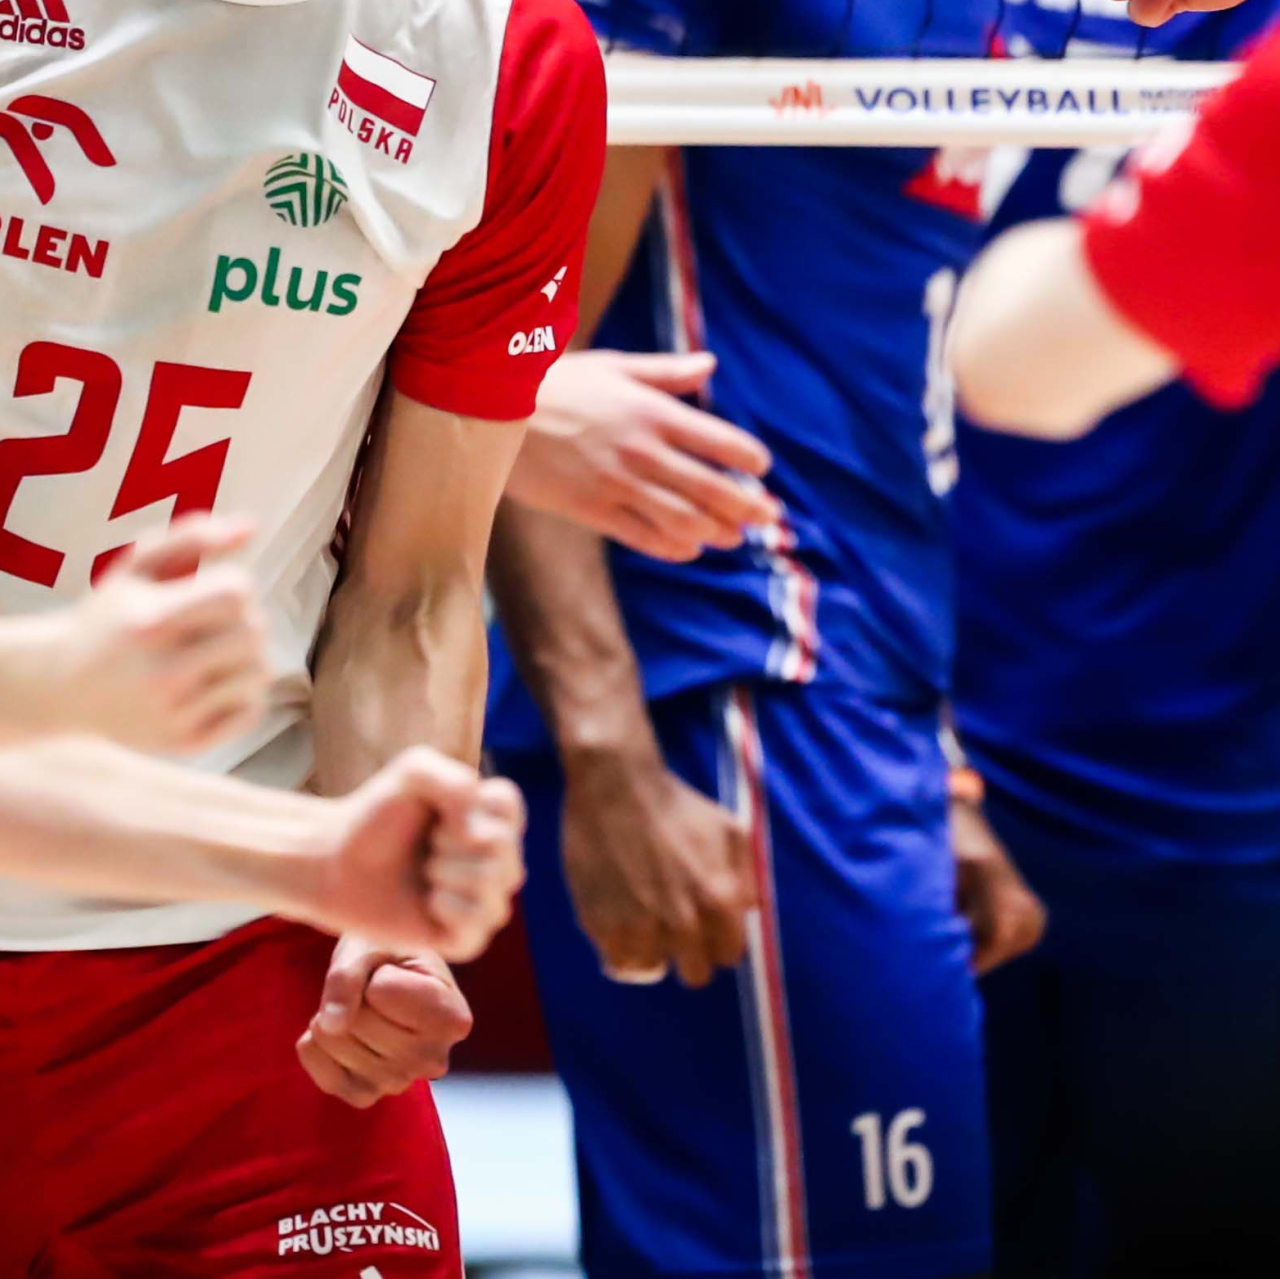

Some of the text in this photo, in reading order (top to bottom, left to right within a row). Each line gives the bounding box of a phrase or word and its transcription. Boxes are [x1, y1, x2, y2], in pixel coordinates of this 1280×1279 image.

[327, 86, 414, 165] POLSKA
[854, 87, 1131, 115] VOLLEYBALL
[208, 246, 363, 316] plus
[851, 1107, 933, 1210] 16
[278, 1201, 385, 1235] BLACHY
[278, 1222, 440, 1256] PRUSZYŃSKI
